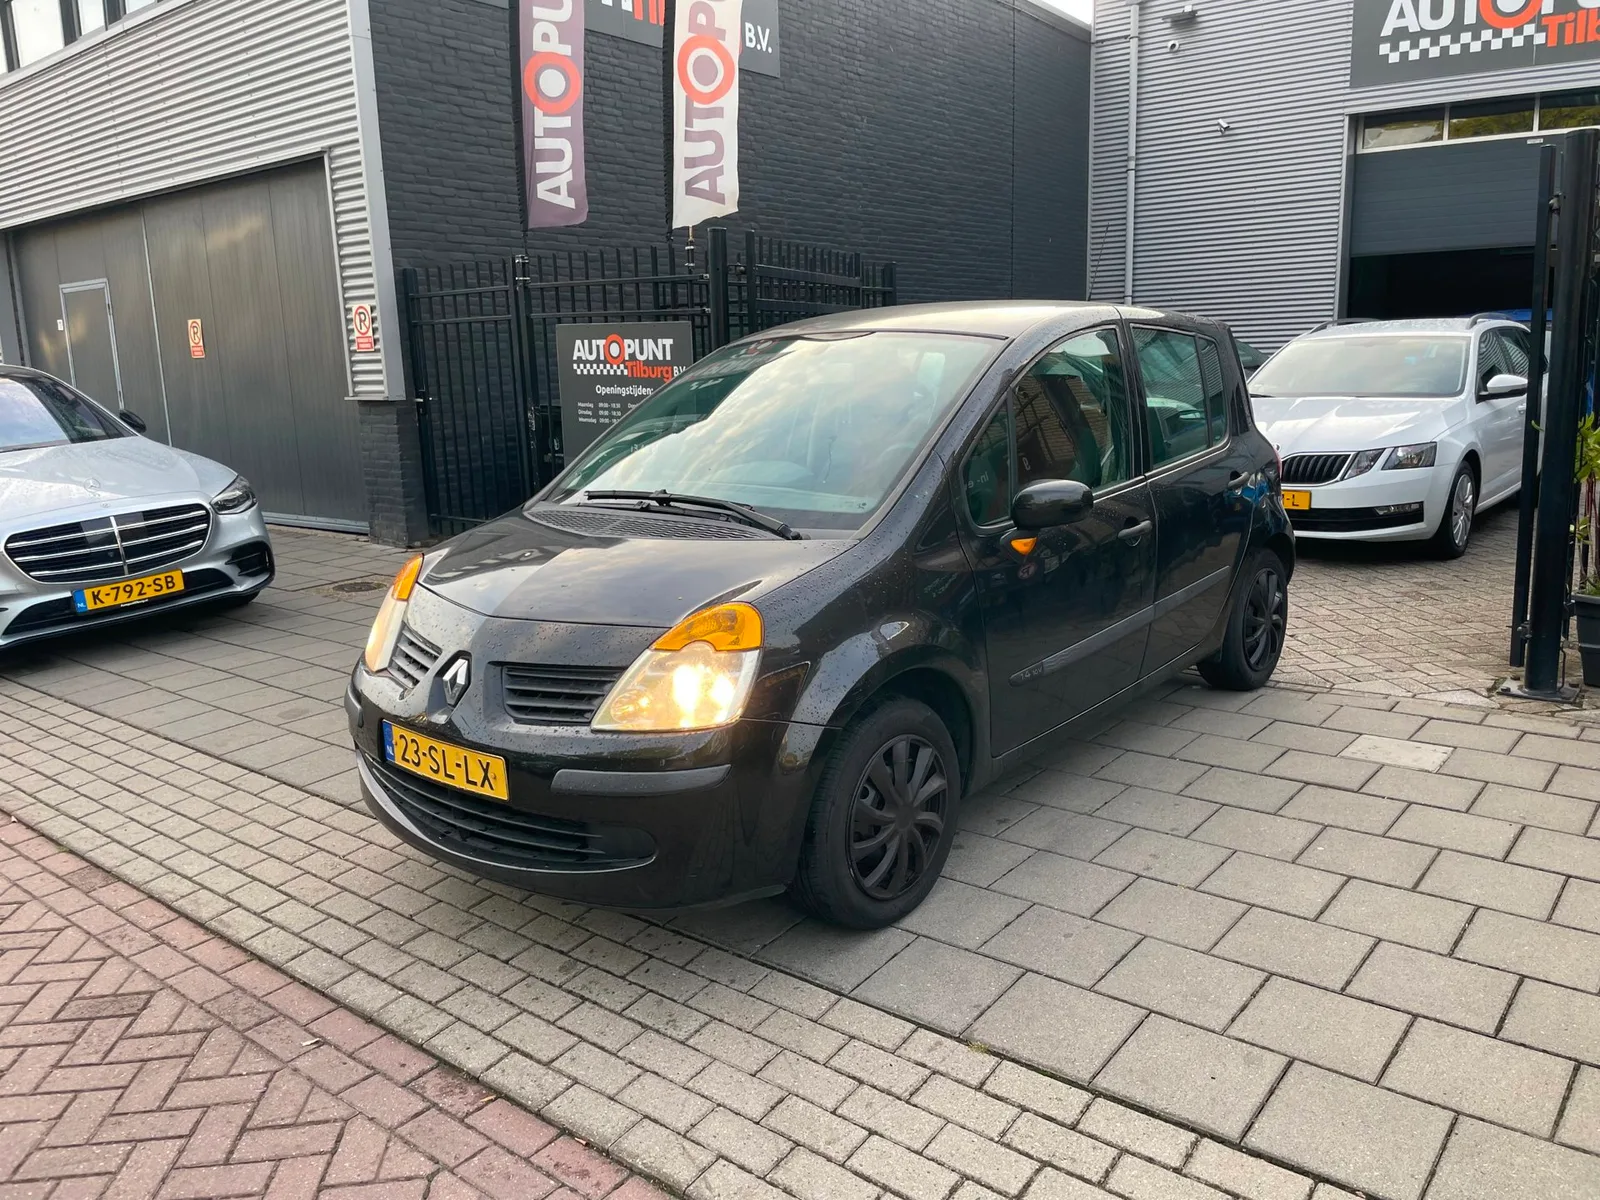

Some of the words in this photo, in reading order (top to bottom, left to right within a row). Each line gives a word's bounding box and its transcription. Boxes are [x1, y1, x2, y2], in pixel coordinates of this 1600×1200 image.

[745, 22, 773, 54] B.V.
[573, 334, 674, 365] AUTOPUNT
[625, 360, 673, 384] Tilburg
[92, 576, 176, 605] K-792-SB
[399, 734, 494, 791] 23-SL-LX
